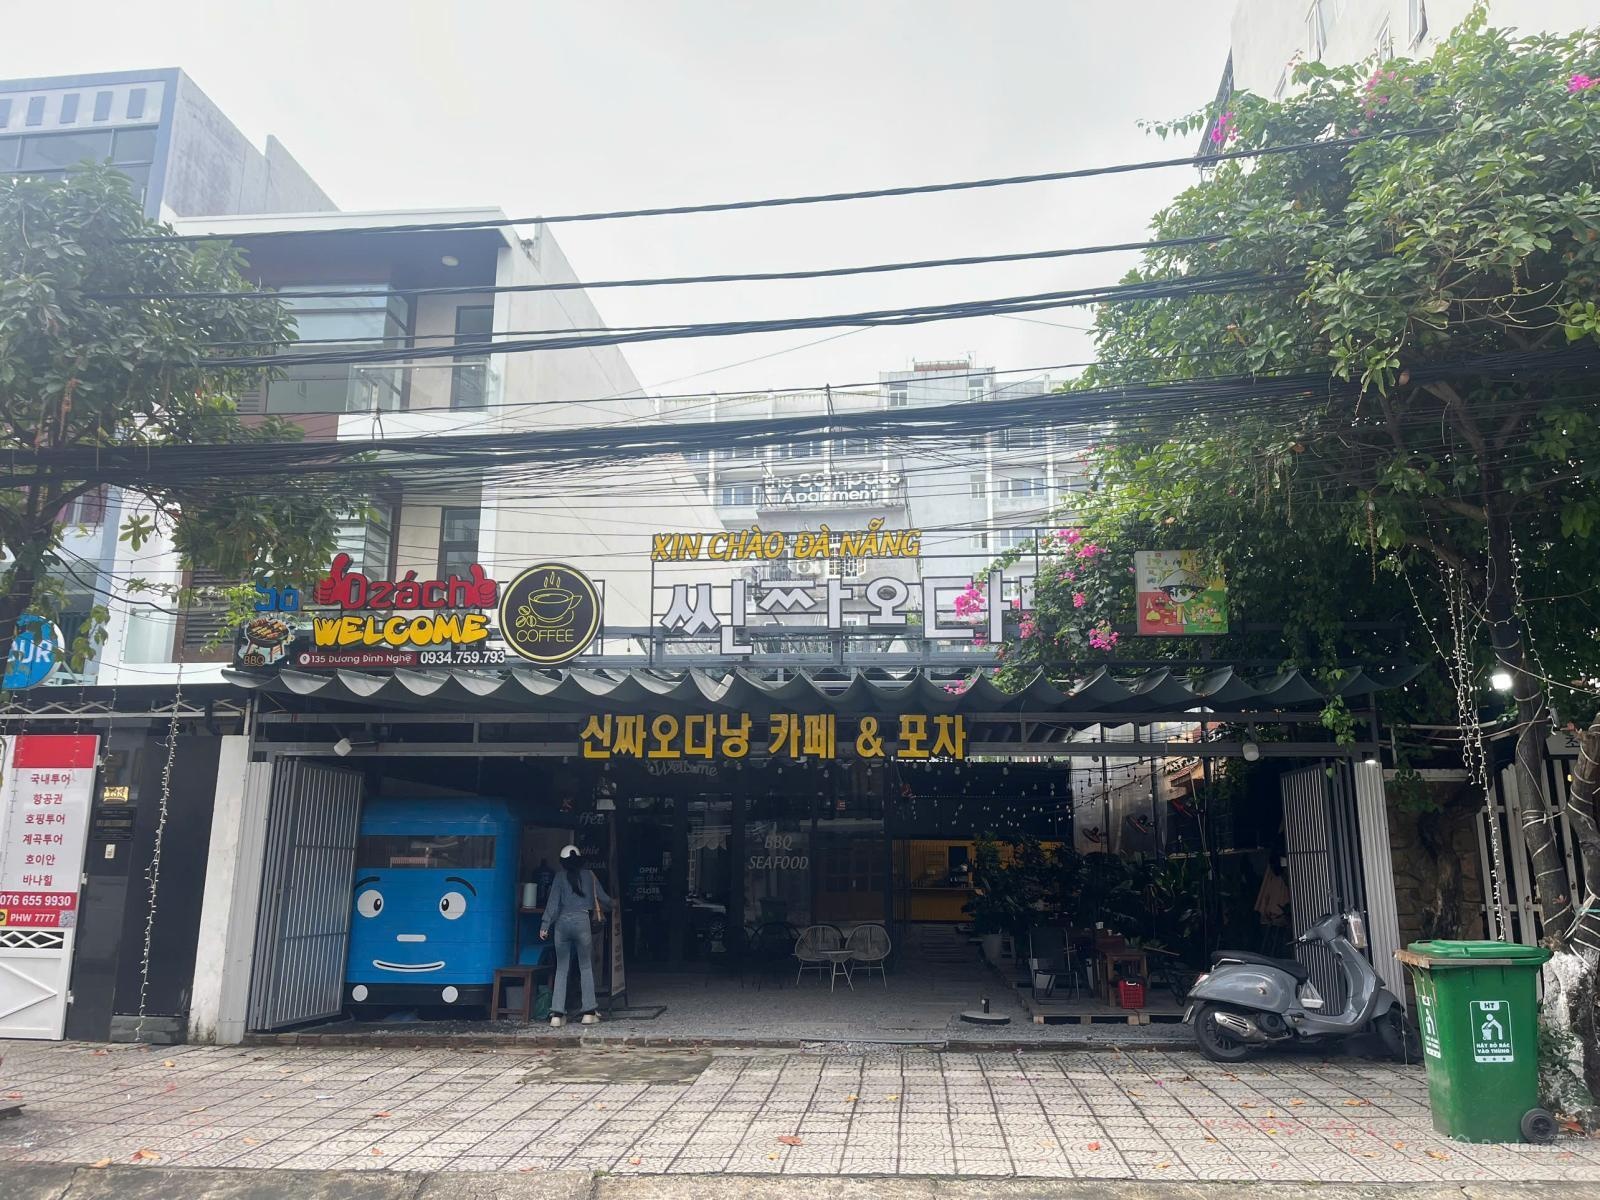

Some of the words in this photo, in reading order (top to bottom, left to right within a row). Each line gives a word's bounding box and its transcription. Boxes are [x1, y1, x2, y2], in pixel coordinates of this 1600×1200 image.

[651, 532, 702, 561] XIN
[707, 524, 785, 561] CHÀO
[793, 524, 831, 561] ĐÀ
[659, 569, 1037, 656] 씬짜오다
[313, 614, 490, 647] WELCOME
[516, 629, 575, 643] COFFEE
[243, 654, 266, 667] BBQ
[311, 655, 326, 663] 135
[420, 651, 506, 664] 0934.759.793
[580, 712, 753, 759] 신짜오다낭
[768, 713, 836, 760] 카페
[856, 716, 885, 758] &
[897, 714, 967, 760] 포차
[31, 773, 71, 785] 국내투어
[33, 794, 63, 805] 항공권
[25, 814, 66, 825] 호핑투어
[23, 834, 63, 845] 계곡투어
[764, 834, 792, 851] BBQ
[25, 854, 55, 866] 호이안
[750, 855, 809, 870] SEAFOOD
[639, 866, 658, 874] OPEN
[22, 874, 52, 886] 바나힐
[0, 895, 19, 906] 076
[22, 895, 42, 906] 655
[44, 896, 71, 906] 9930
[10, 914, 32, 923] PHW
[35, 914, 55, 923] 7777
